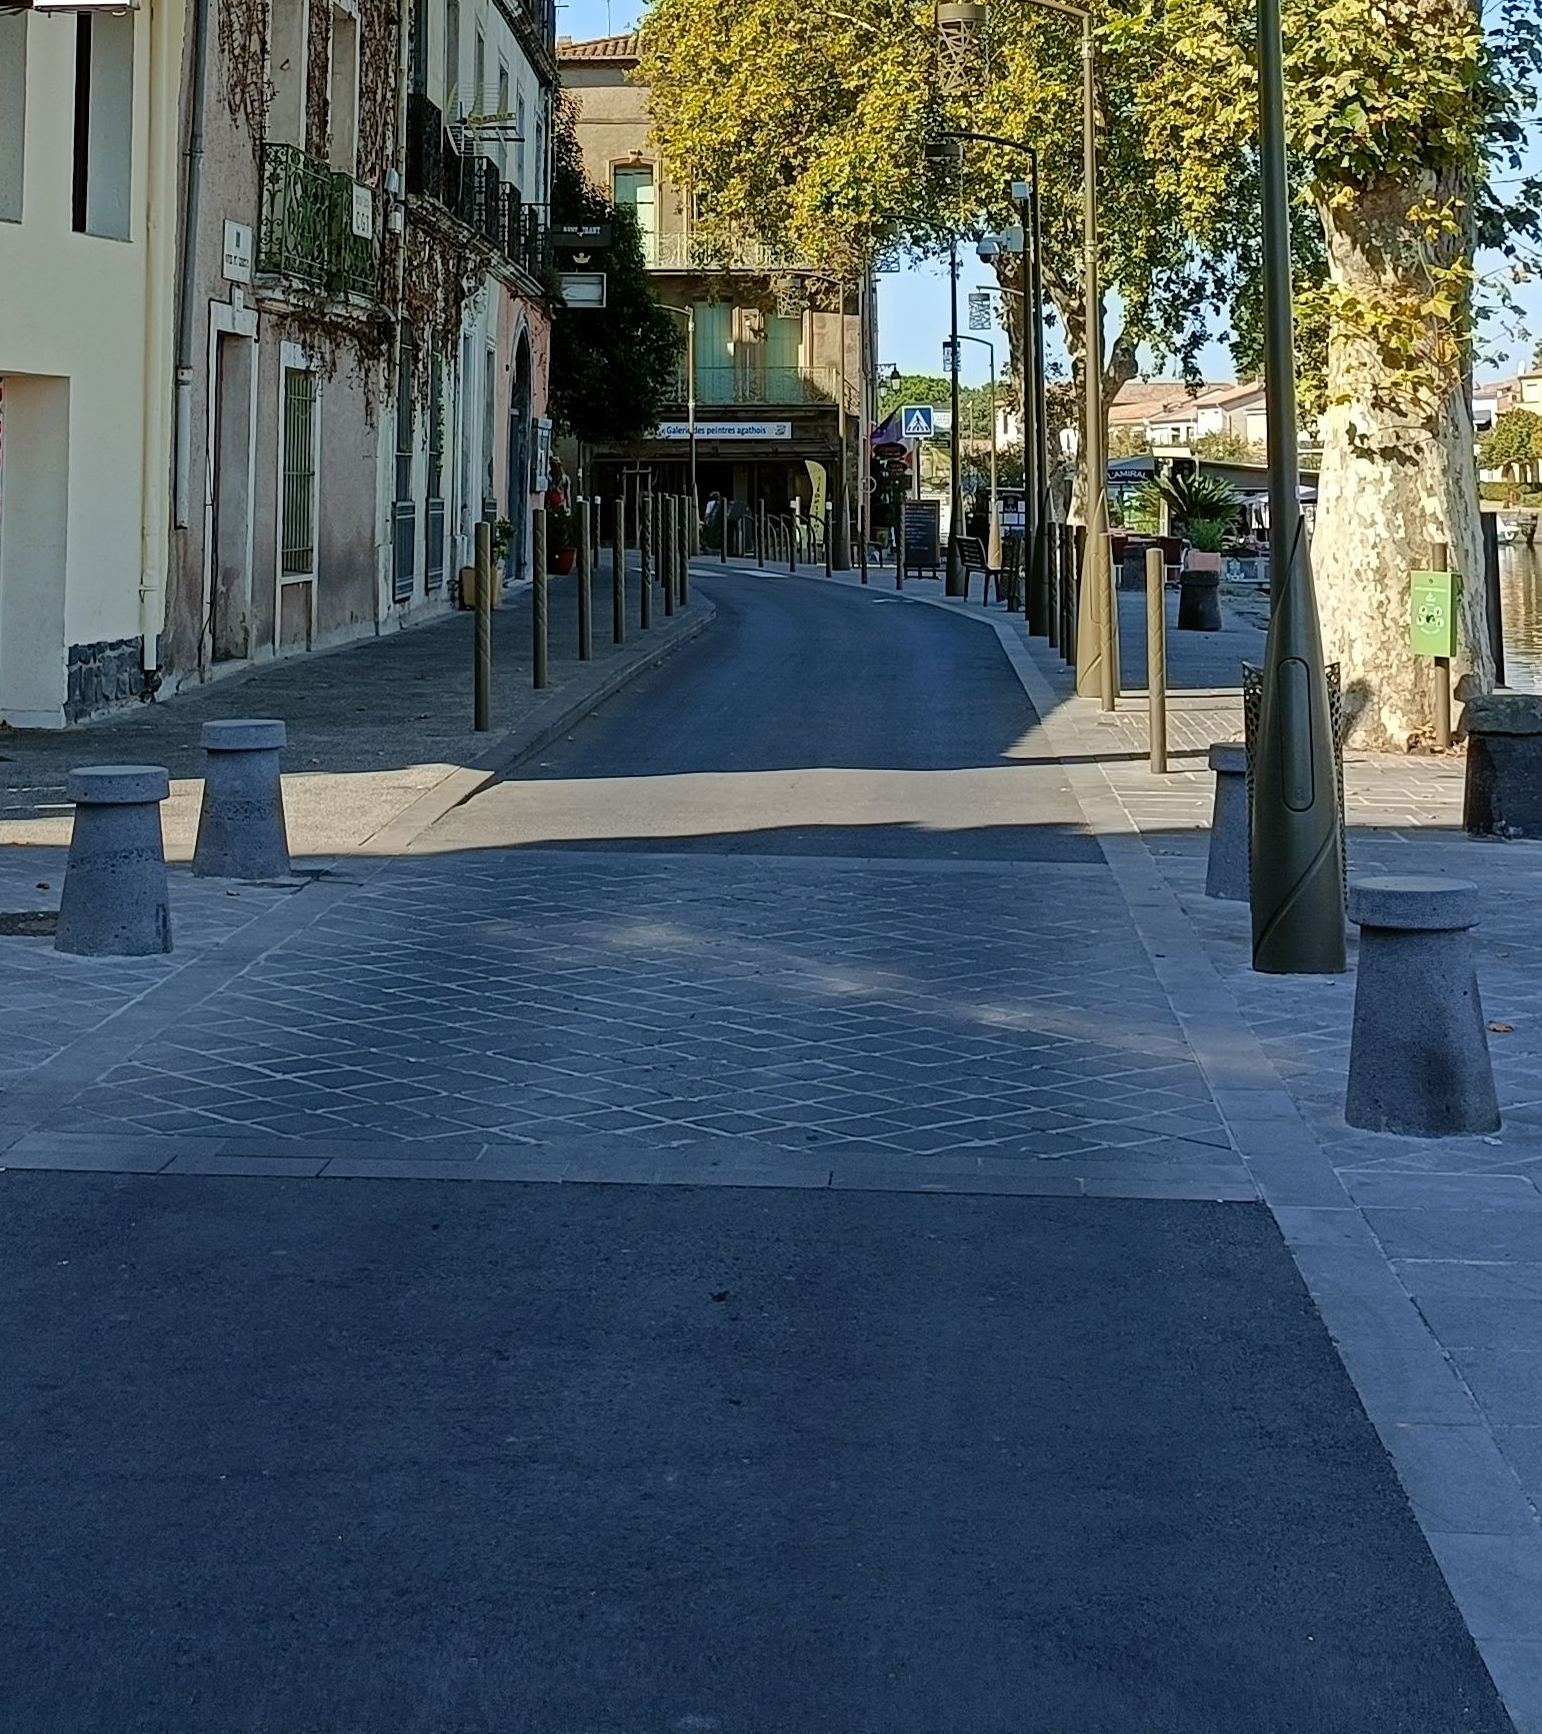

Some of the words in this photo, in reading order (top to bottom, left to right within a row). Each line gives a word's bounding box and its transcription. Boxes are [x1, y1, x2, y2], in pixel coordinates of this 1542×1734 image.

[666, 425, 691, 435] Galeri
[707, 425, 736, 436] peintres
[737, 425, 767, 436] agathois
